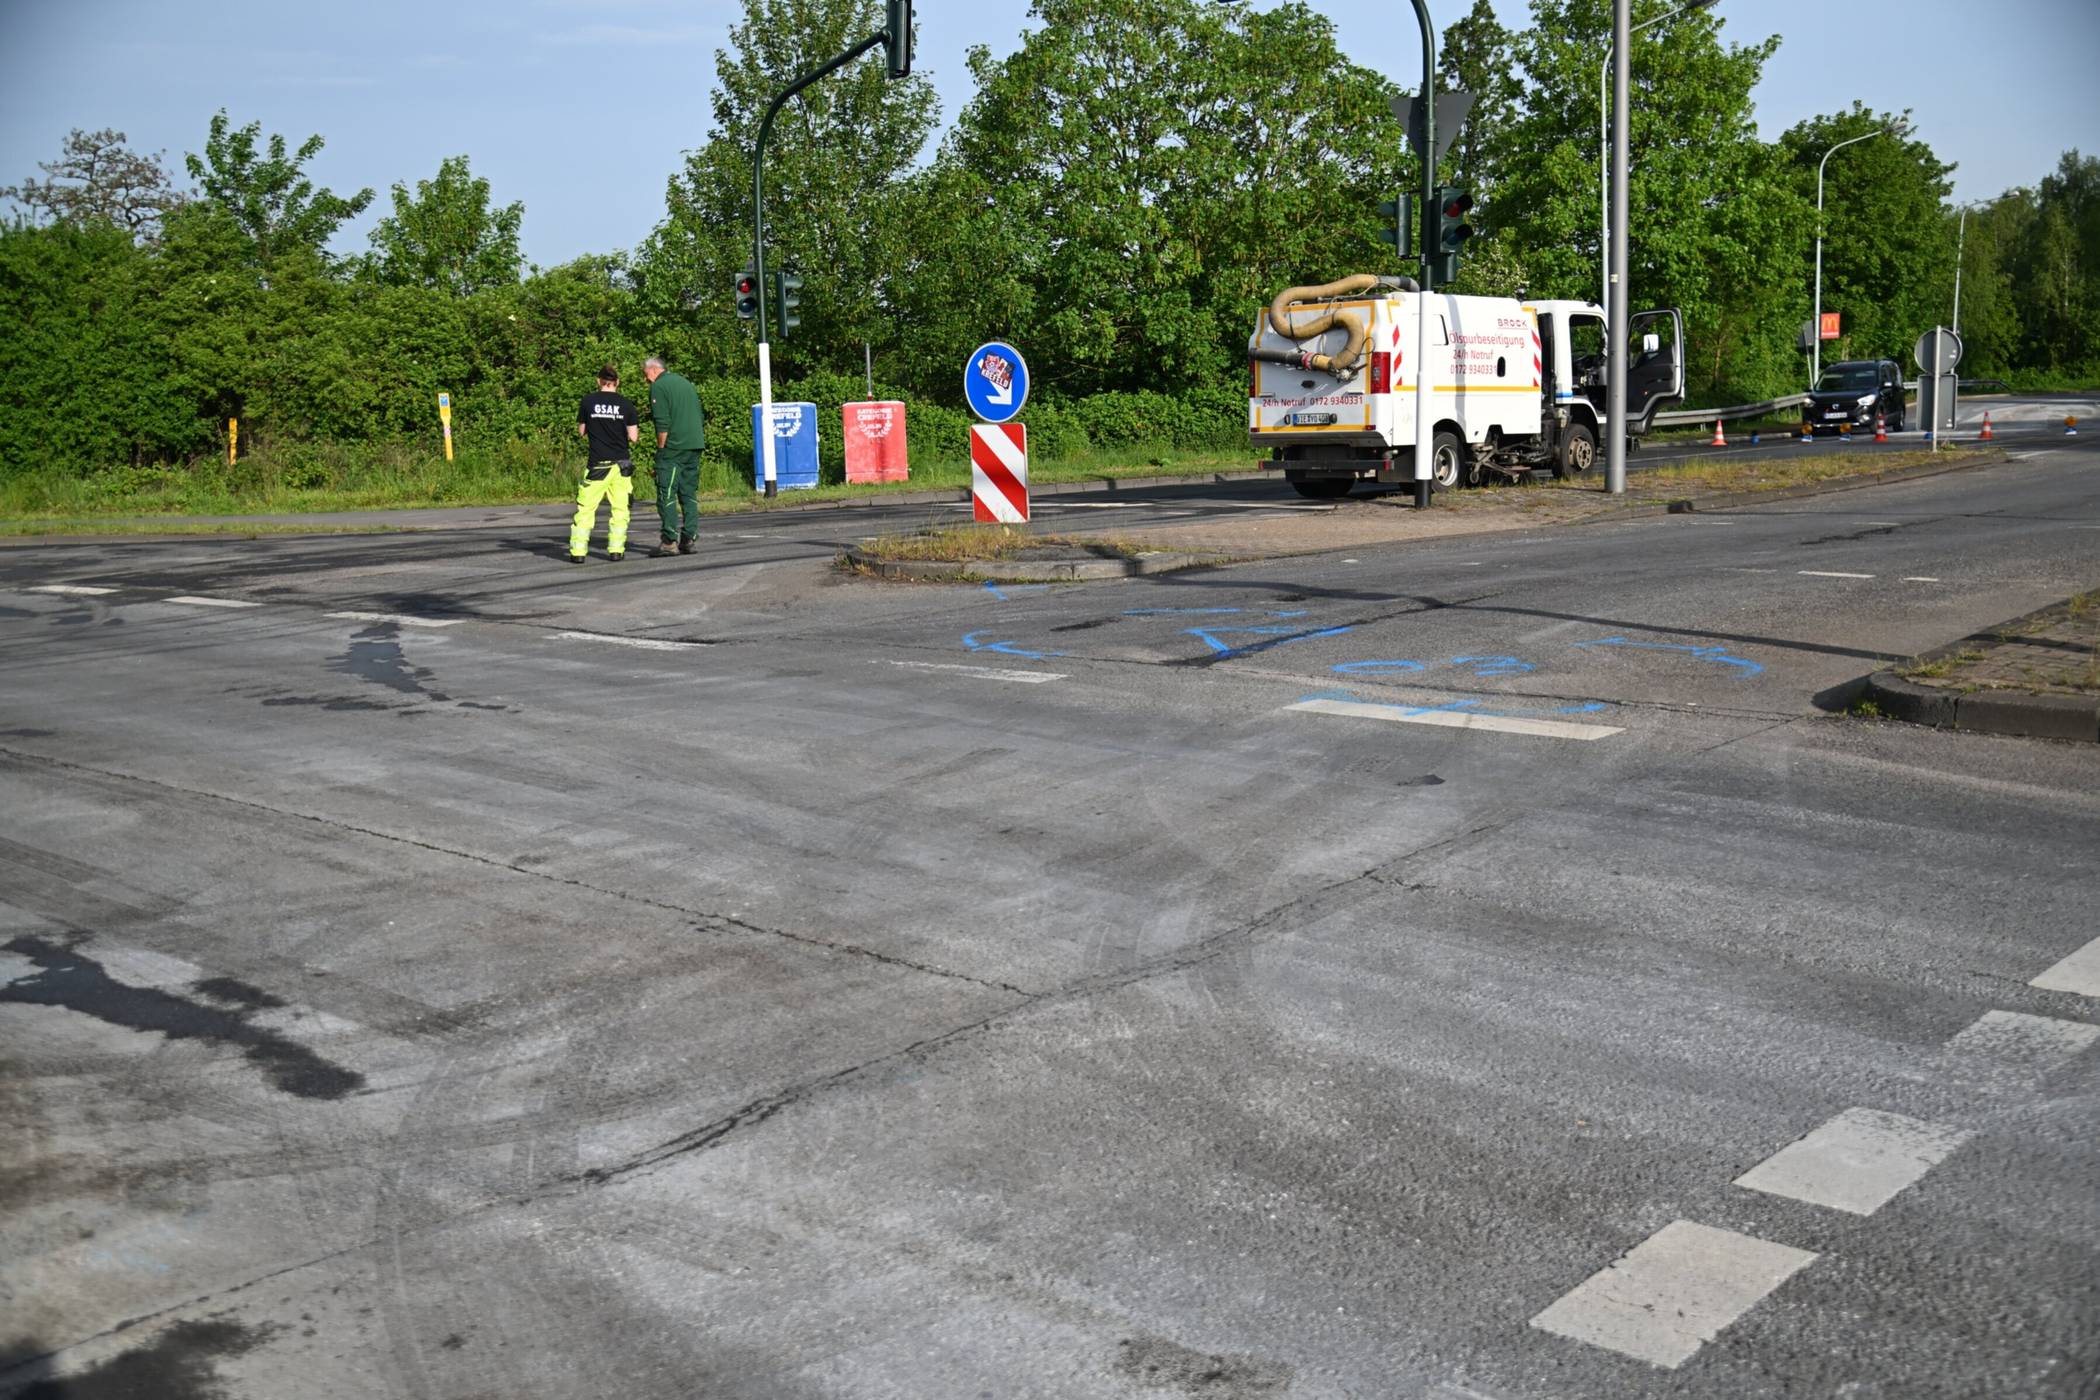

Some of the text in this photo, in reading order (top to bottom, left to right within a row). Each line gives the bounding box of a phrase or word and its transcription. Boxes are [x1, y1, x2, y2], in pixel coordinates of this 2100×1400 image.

[1497, 318, 1527, 327] BROCK
[1471, 349, 1494, 360] Notruf
[1450, 364, 1466, 375] 0172
[1281, 397, 1306, 407] Notruf
[1310, 397, 1329, 406] 0172
[1330, 395, 1363, 405] 9340331
[594, 404, 620, 415] GSAK
